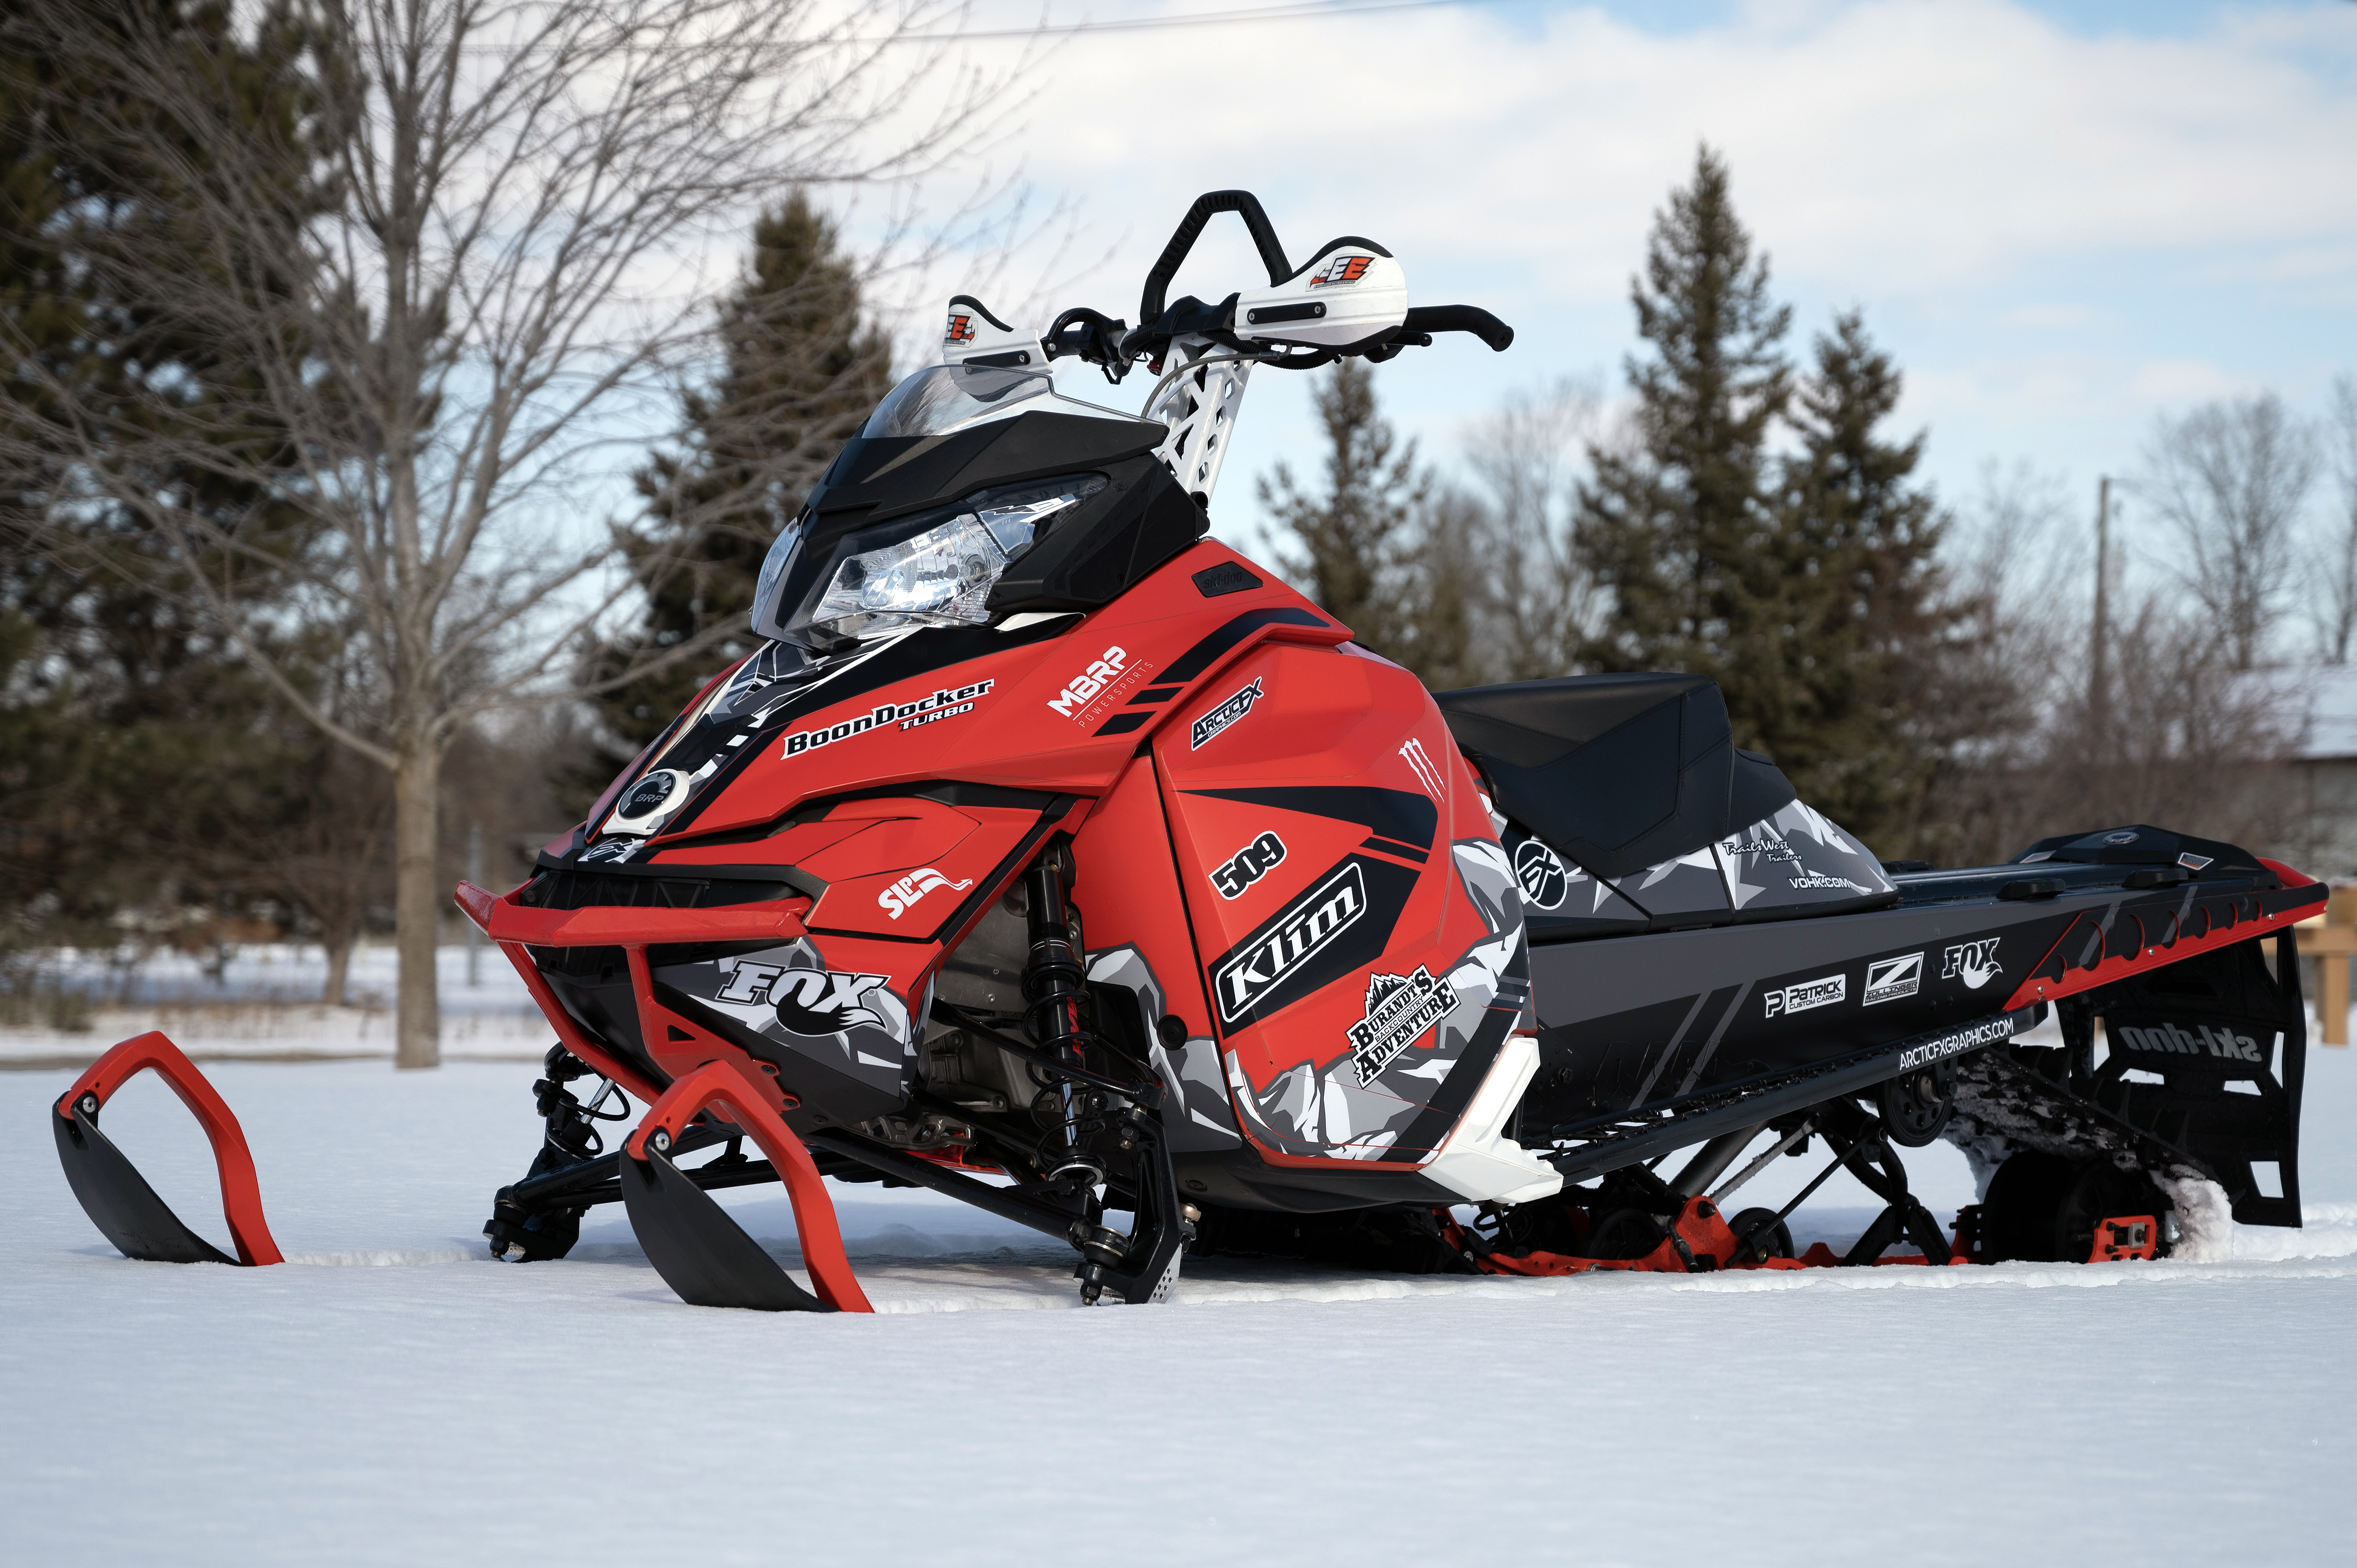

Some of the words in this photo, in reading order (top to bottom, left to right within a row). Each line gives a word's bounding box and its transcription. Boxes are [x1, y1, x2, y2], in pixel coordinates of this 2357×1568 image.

[1203, 571, 1242, 589] ski-doo
[1046, 645, 1127, 718] MBRP
[1078, 662, 1153, 728] POWERSPORTS
[781, 679, 994, 759] BoonDocker
[899, 701, 975, 732] TURBO
[634, 794, 664, 803] BRP
[1208, 831, 1287, 900] 509
[1767, 853, 1802, 862] Trailers
[878, 876, 925, 921] SLP
[1788, 876, 1851, 889] VOHK.COM
[1942, 937, 2001, 979] FOX
[715, 960, 891, 1015] FOX
[1789, 999, 1815, 1010] CUSTOM
[1816, 992, 1843, 1003] CARBON
[1865, 994, 1888, 1002] RACING
[1888, 987, 1917, 997] PRODUCTS
[1866, 982, 1918, 998] ZOLLINGER
[1350, 969, 1433, 1052] BURANDT'S
[1356, 981, 1457, 1083] ADVENTURE
[1374, 996, 1424, 1043] BACKCOUNTRY
[1900, 1017, 2014, 1071] ARCTICFXGRAPHICS.COM
